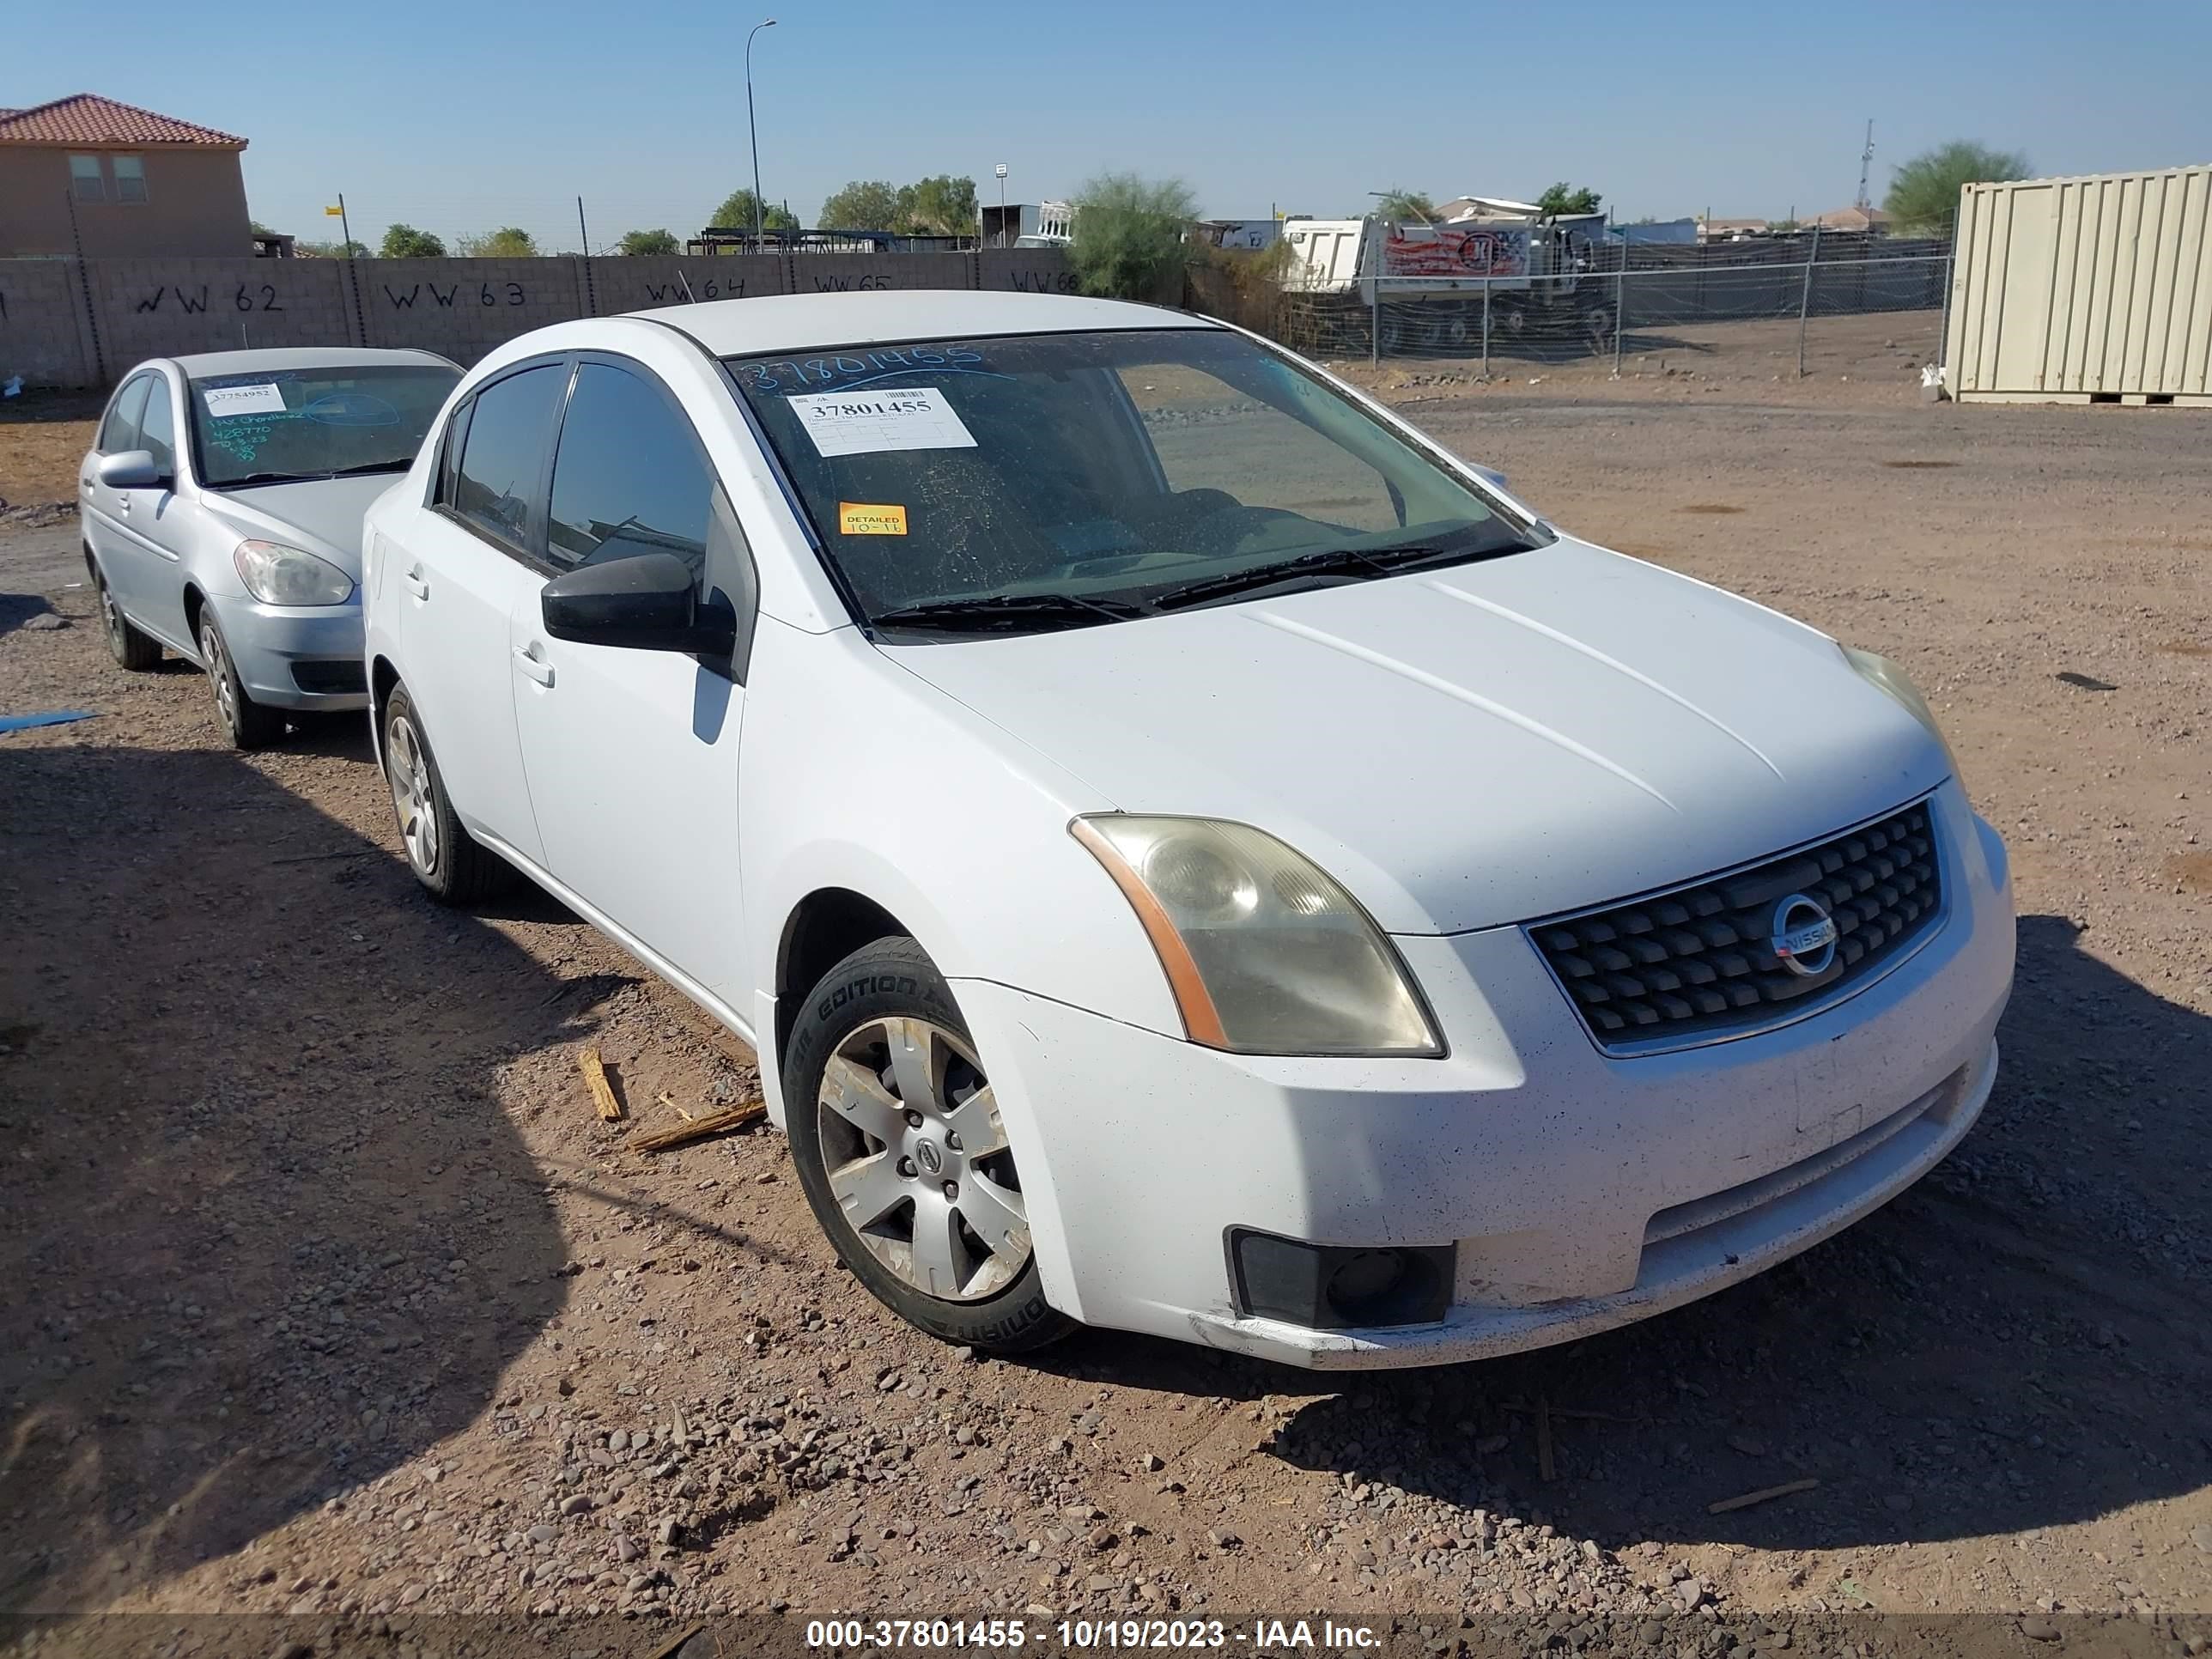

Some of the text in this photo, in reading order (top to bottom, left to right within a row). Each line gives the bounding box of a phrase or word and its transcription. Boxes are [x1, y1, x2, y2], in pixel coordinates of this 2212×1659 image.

[704, 278, 744, 298] 64
[859, 275, 891, 291] 65
[1057, 271, 1079, 292] 66
[236, 284, 283, 312] 62
[482, 283, 526, 307] 63
[744, 347, 982, 389] 37801455
[810, 399, 932, 419] 37801455
[851, 523, 902, 533] 10-16
[817, 975, 918, 1022] EDITION
